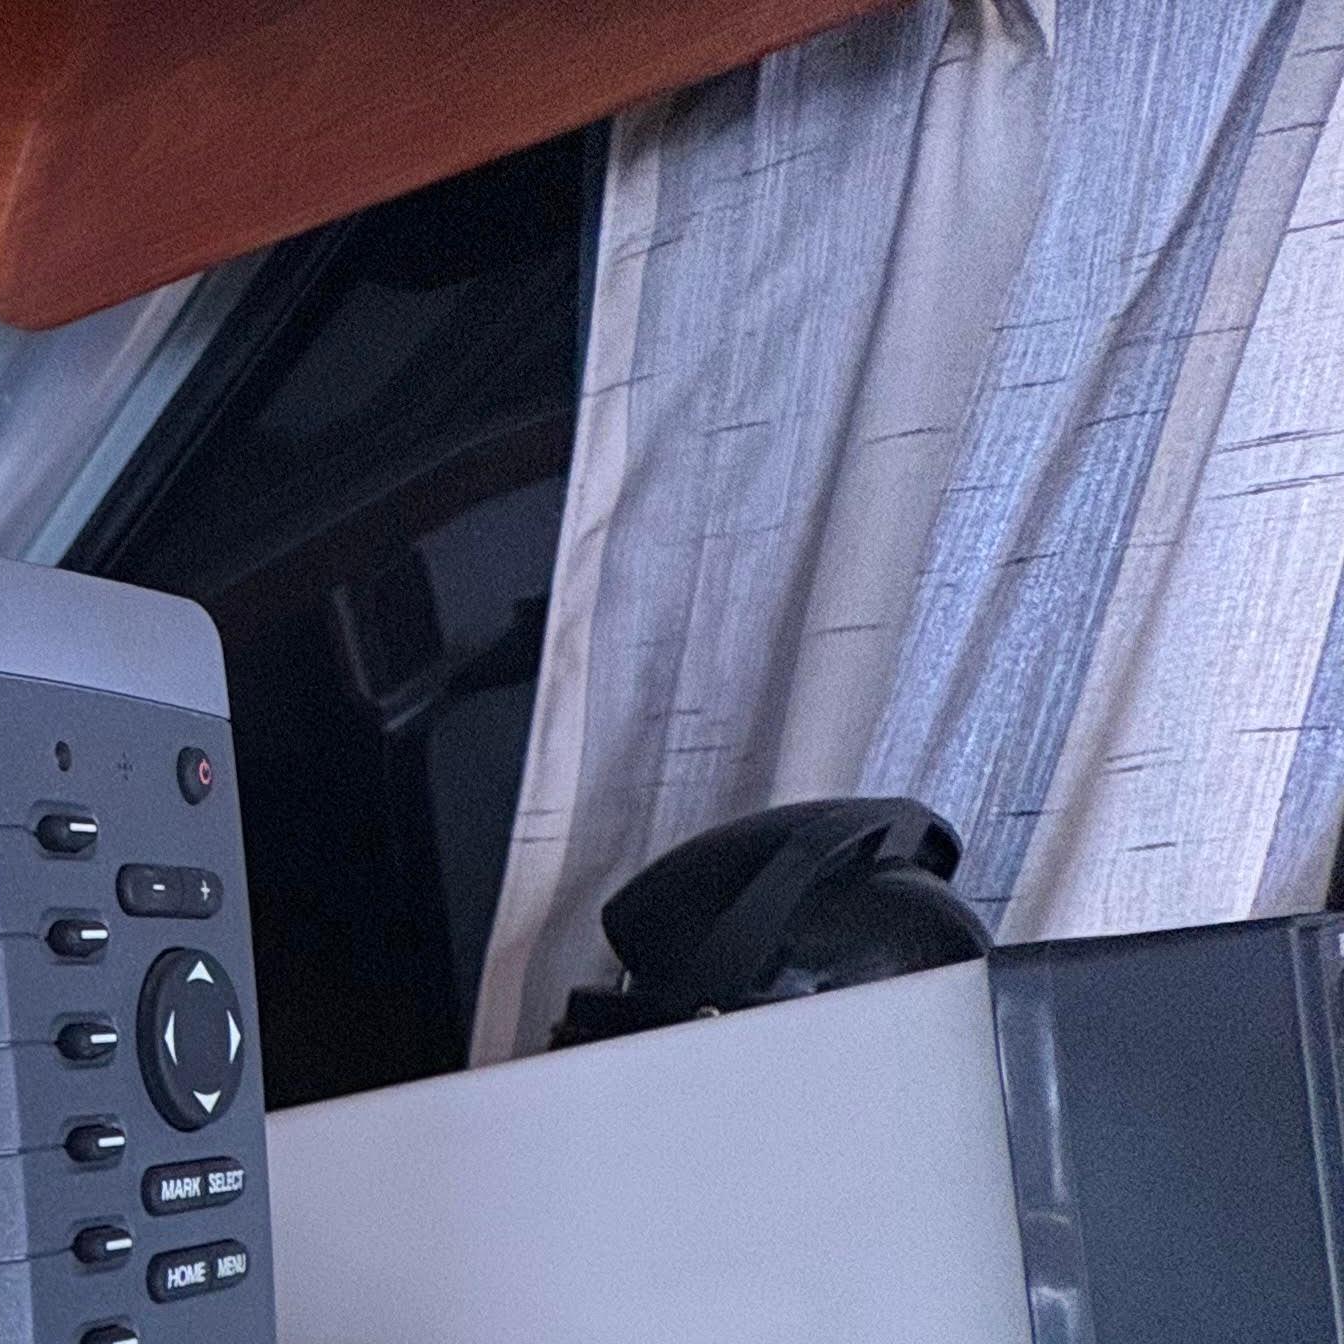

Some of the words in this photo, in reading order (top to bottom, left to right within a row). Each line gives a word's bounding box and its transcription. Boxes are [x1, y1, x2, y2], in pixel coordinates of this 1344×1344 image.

[161, 1176, 202, 1201] MARK
[207, 1169, 245, 1194] SELECT
[167, 1261, 207, 1290] HOME
[217, 1253, 247, 1279] MENU
